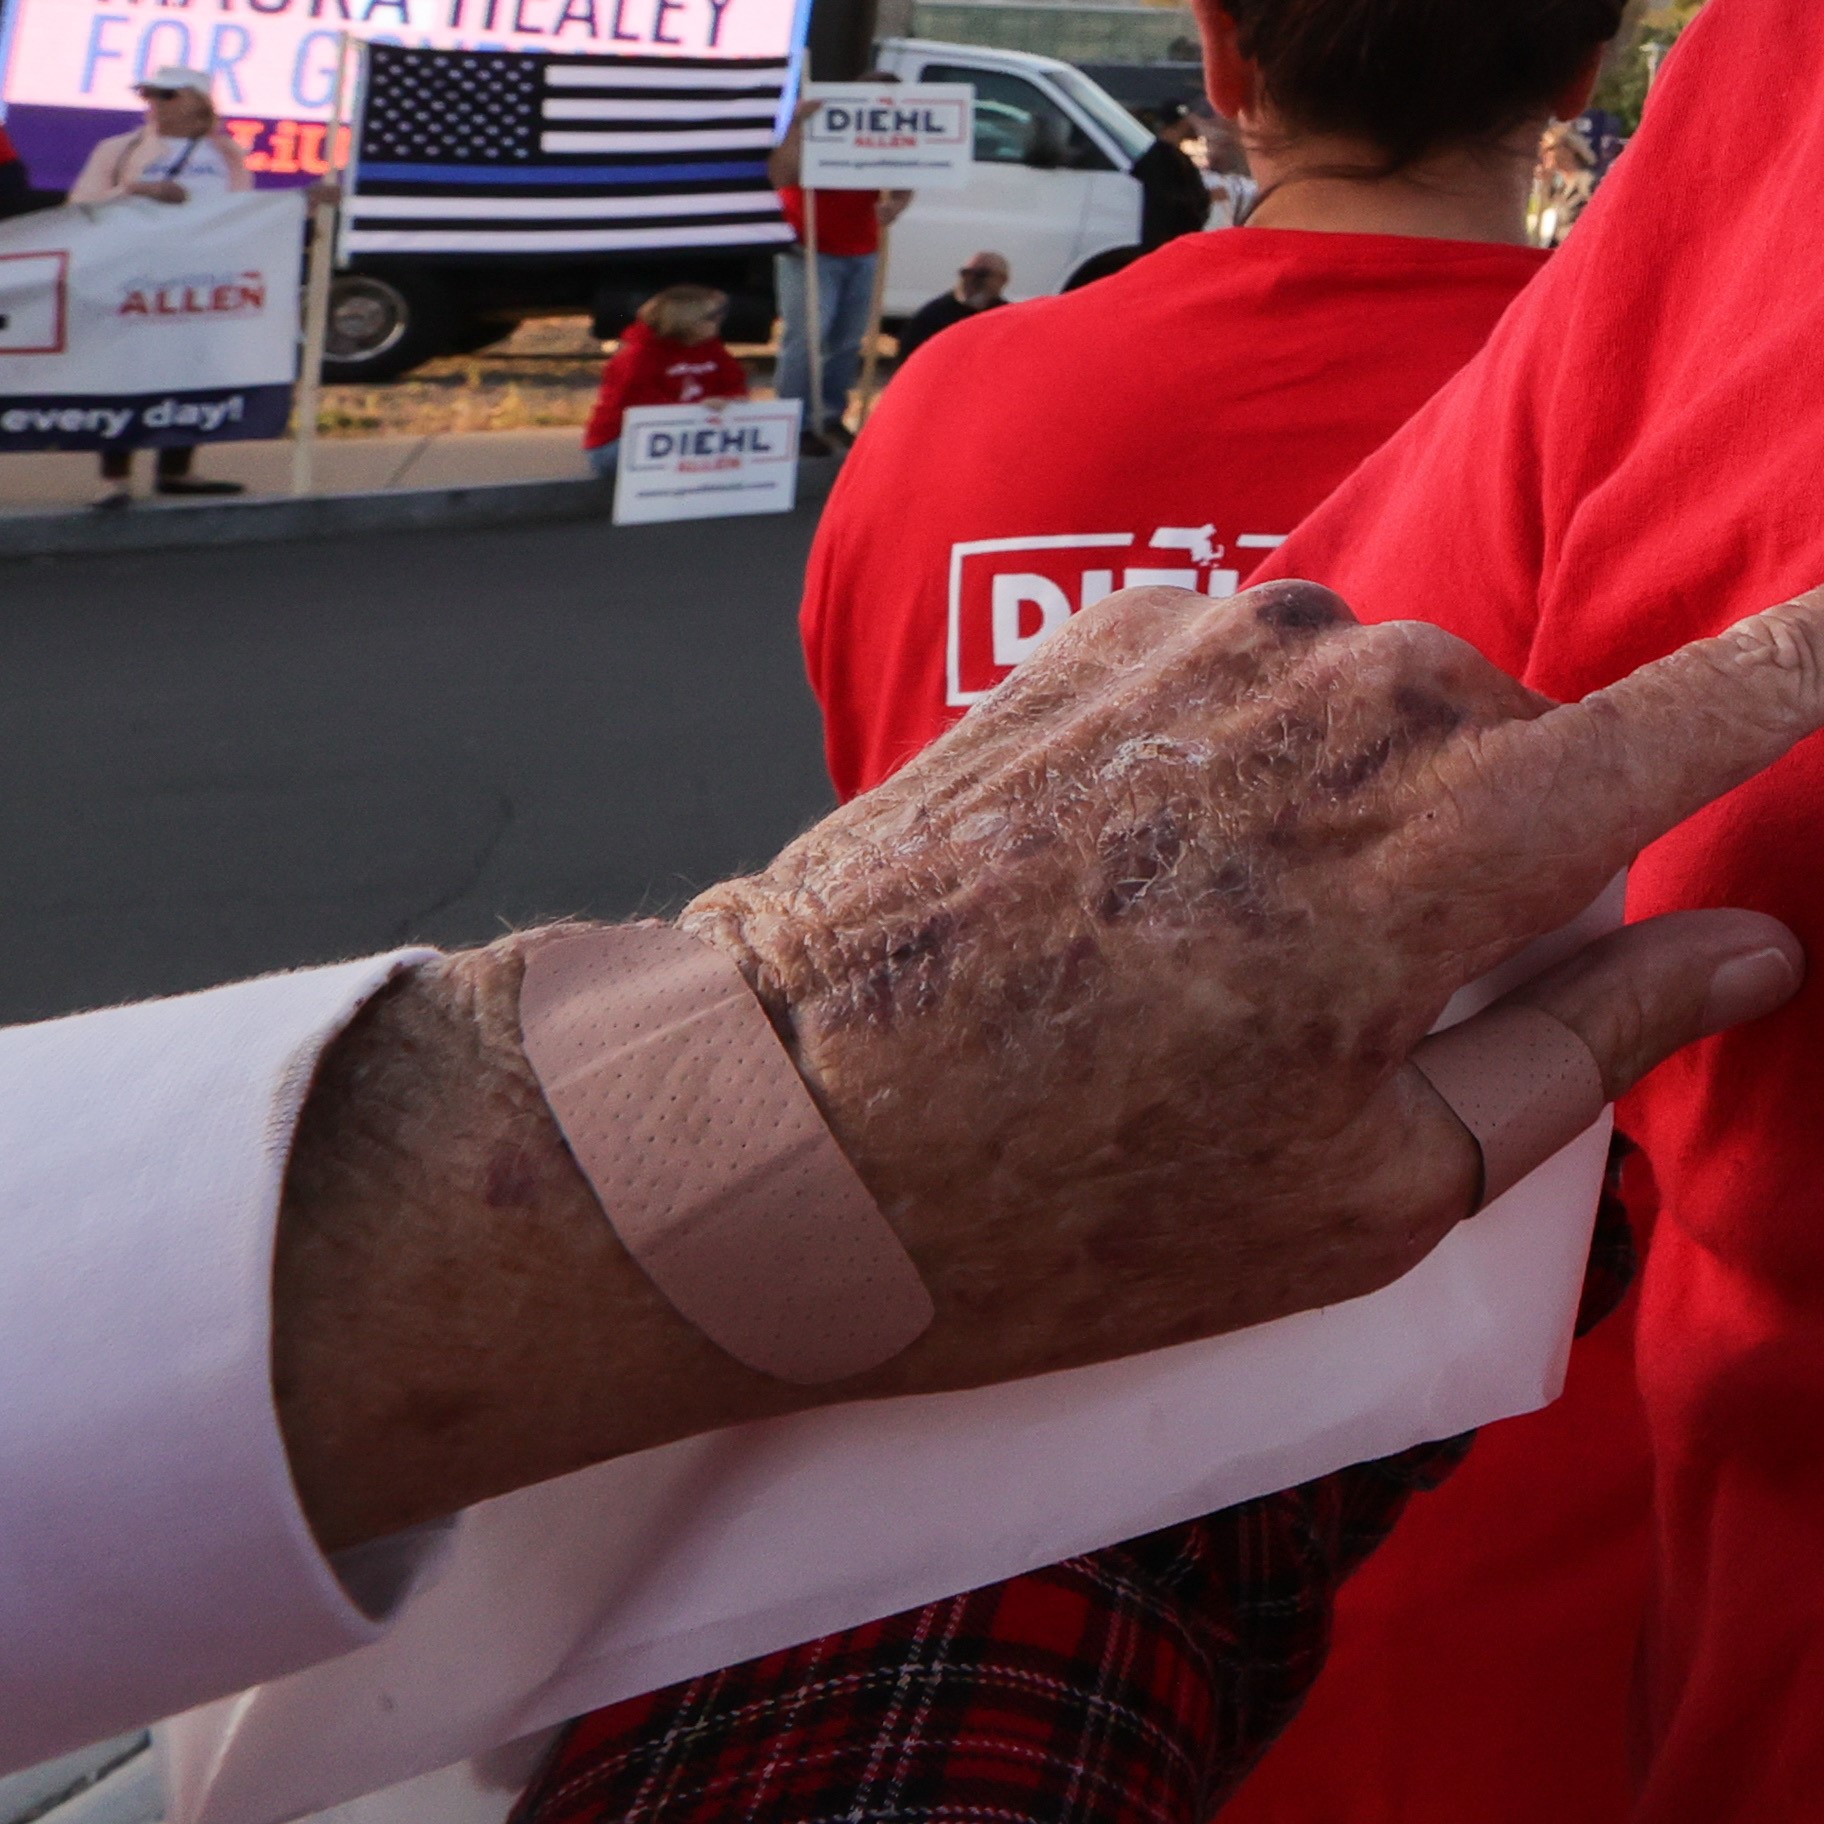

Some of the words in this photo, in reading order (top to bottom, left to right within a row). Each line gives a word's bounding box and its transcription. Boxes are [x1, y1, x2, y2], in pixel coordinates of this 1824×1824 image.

[79, 12, 252, 104] FOR
[826, 108, 945, 132] DIEHL
[119, 284, 266, 316] ALLEN
[1, 407, 135, 439] every
[142, 395, 245, 431] day!
[649, 428, 770, 458] DIEHL
